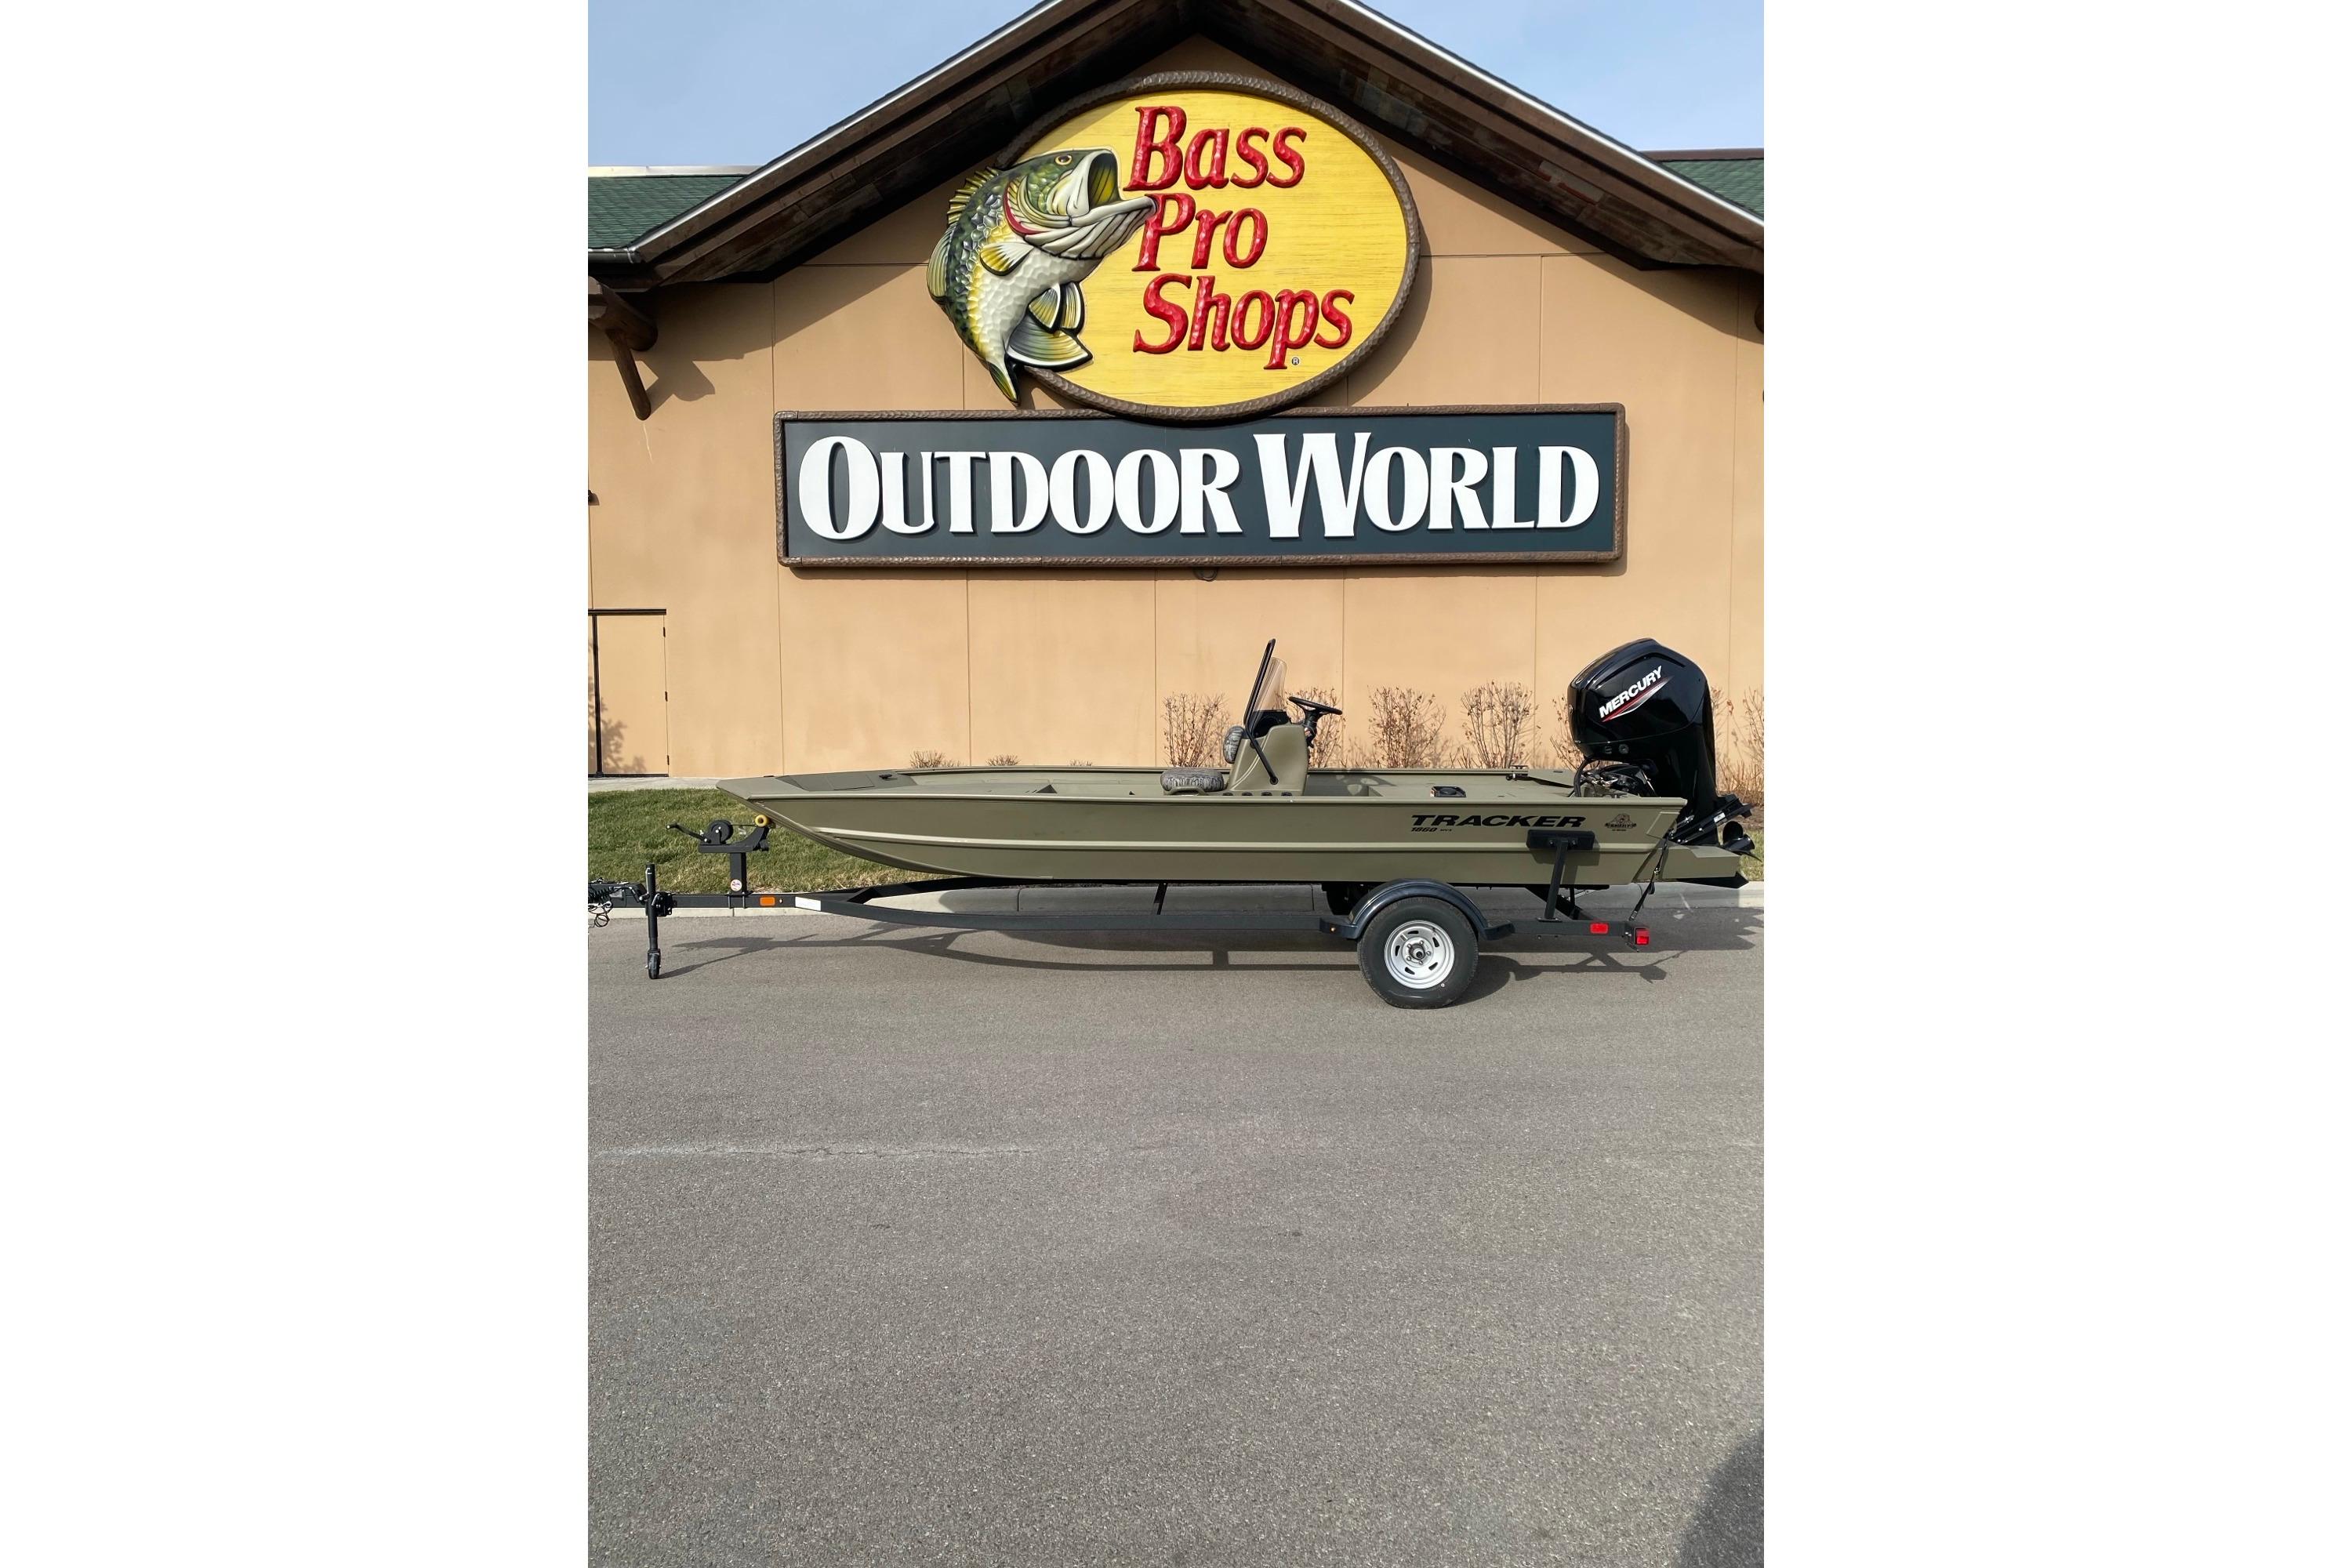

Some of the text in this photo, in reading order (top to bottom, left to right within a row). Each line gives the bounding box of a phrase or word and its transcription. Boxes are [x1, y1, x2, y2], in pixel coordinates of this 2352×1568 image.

[1123, 105, 1308, 191] Bass
[1131, 193, 1269, 272] Pro
[1133, 273, 1356, 370] Shops
[798, 432, 1600, 541] OUTDOOR WORLD
[1599, 665, 1662, 719] MERCURY
[1410, 815, 1587, 828] TRACKER
